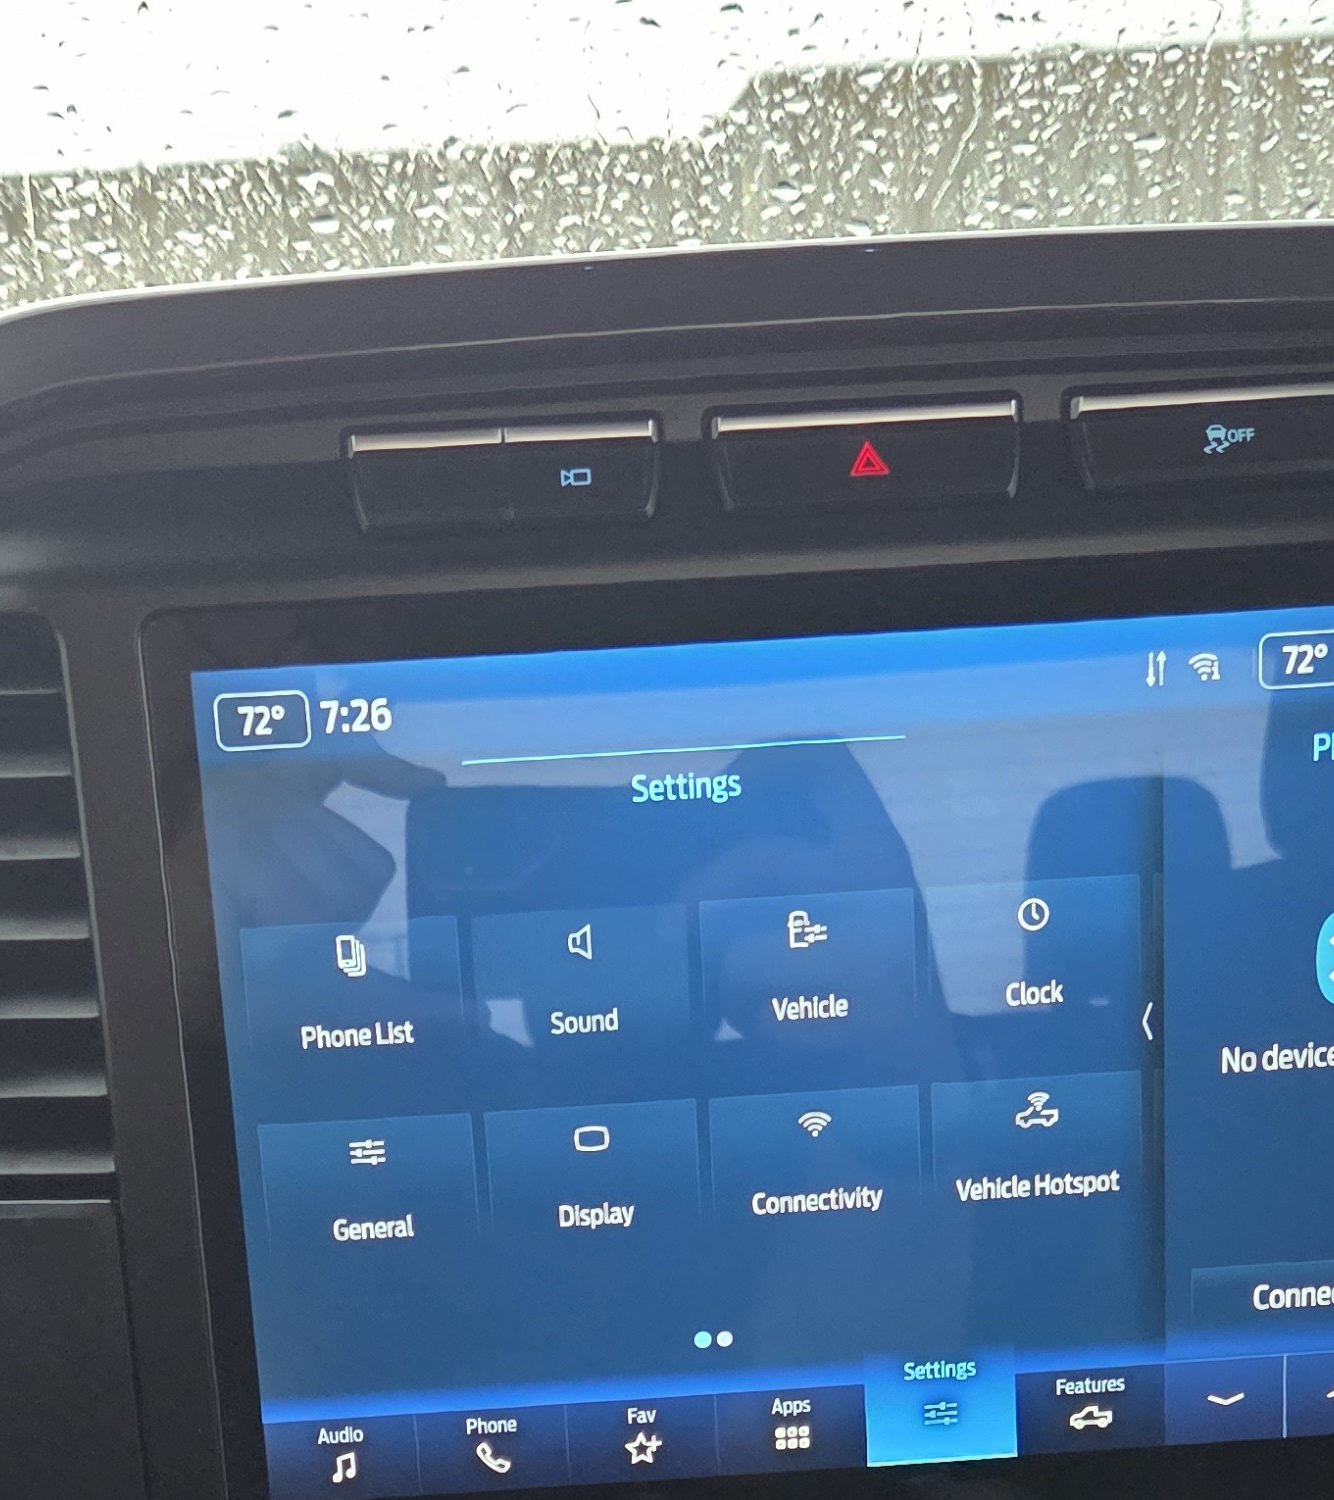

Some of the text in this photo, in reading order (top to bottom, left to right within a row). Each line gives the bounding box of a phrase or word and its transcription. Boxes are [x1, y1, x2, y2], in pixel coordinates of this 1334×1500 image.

[1227, 427, 1255, 442] OFF
[1282, 643, 1328, 675] 72°
[237, 705, 285, 737] 72°
[319, 697, 392, 734] 7:26
[631, 771, 742, 804] Settings
[1005, 980, 1064, 1006] Clock
[550, 1007, 619, 1035] Sound
[772, 994, 849, 1021] Vehicle
[301, 1019, 415, 1050] Phone List
[1221, 1046, 1258, 1074] No
[752, 1182, 883, 1216] Connectivity
[956, 1168, 1120, 1202] Vehicle Hotspot
[333, 1214, 415, 1242] General
[558, 1202, 635, 1230] Display
[903, 1359, 977, 1384] Settings
[1055, 1374, 1126, 1396] Features
[627, 1406, 656, 1425] Fav
[771, 1396, 811, 1417] Apps
[317, 1425, 364, 1445] Audio
[466, 1415, 517, 1436] Phone
